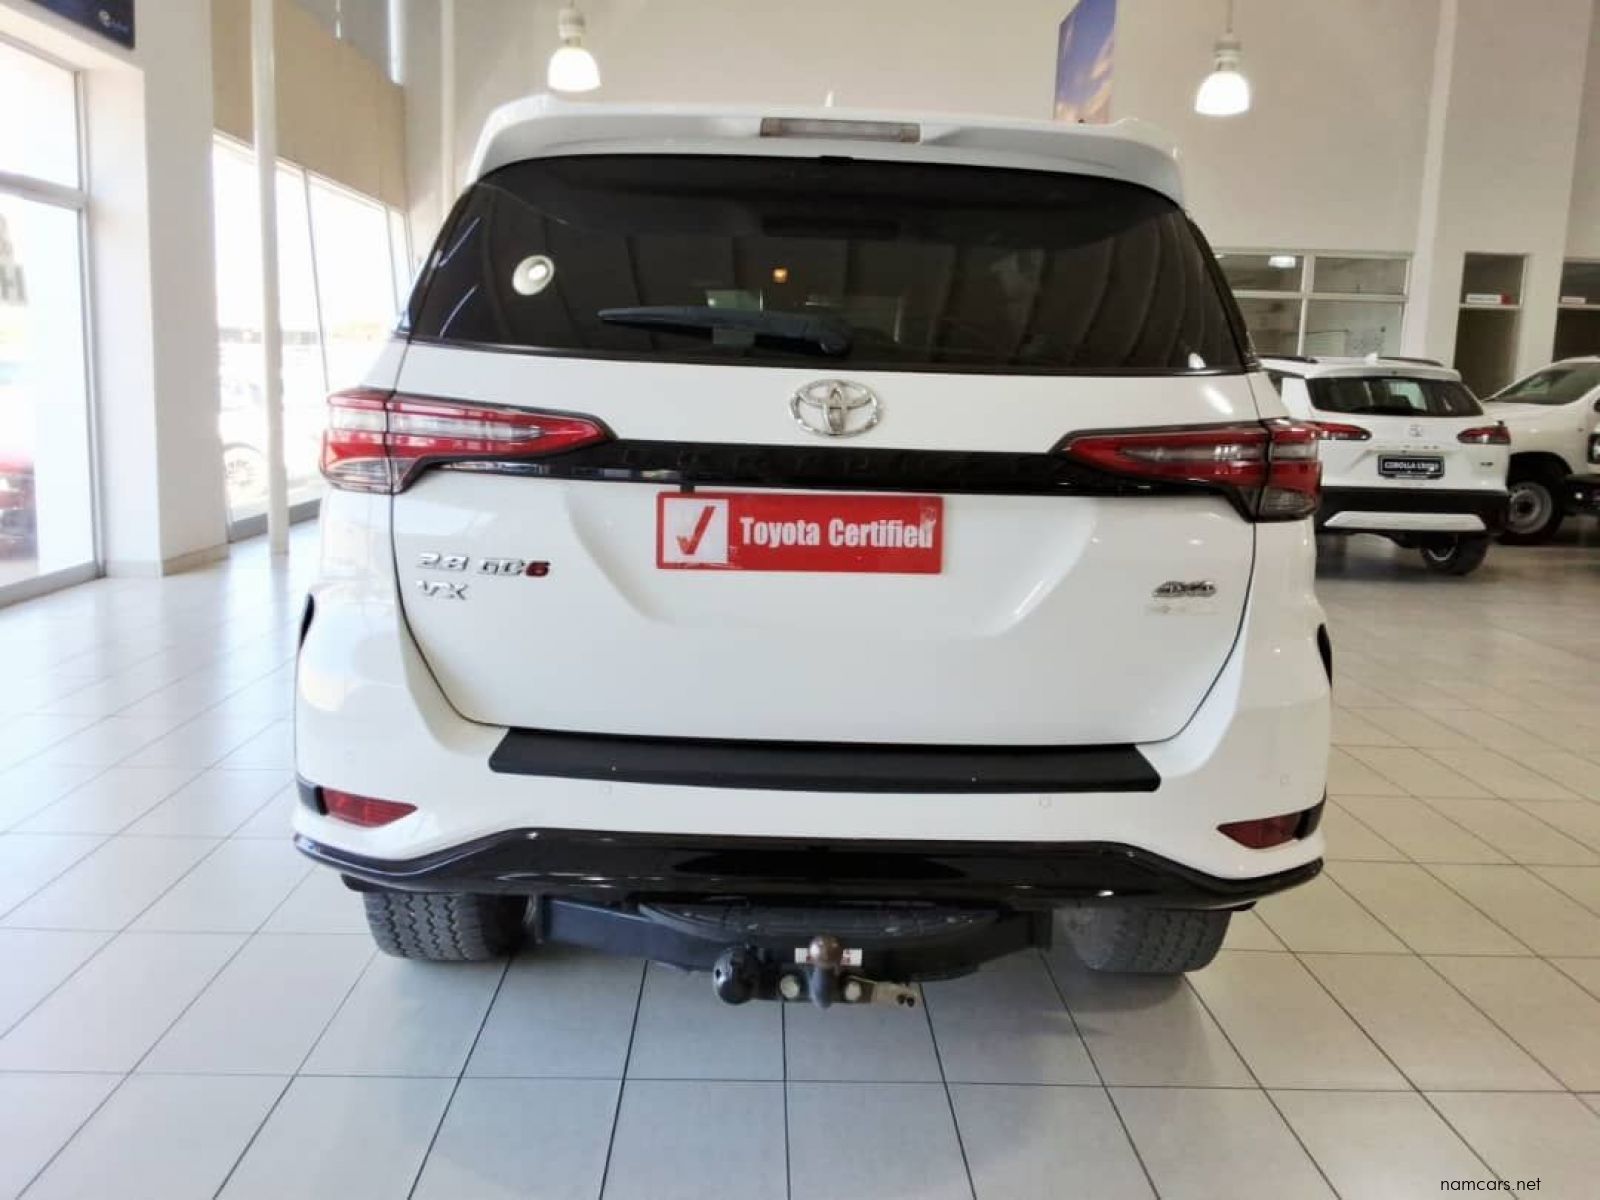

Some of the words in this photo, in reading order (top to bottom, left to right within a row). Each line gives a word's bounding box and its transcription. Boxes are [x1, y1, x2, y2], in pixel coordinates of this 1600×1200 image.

[740, 517, 820, 547] Toyota
[828, 518, 936, 548] Certified
[415, 580, 469, 601] VX
